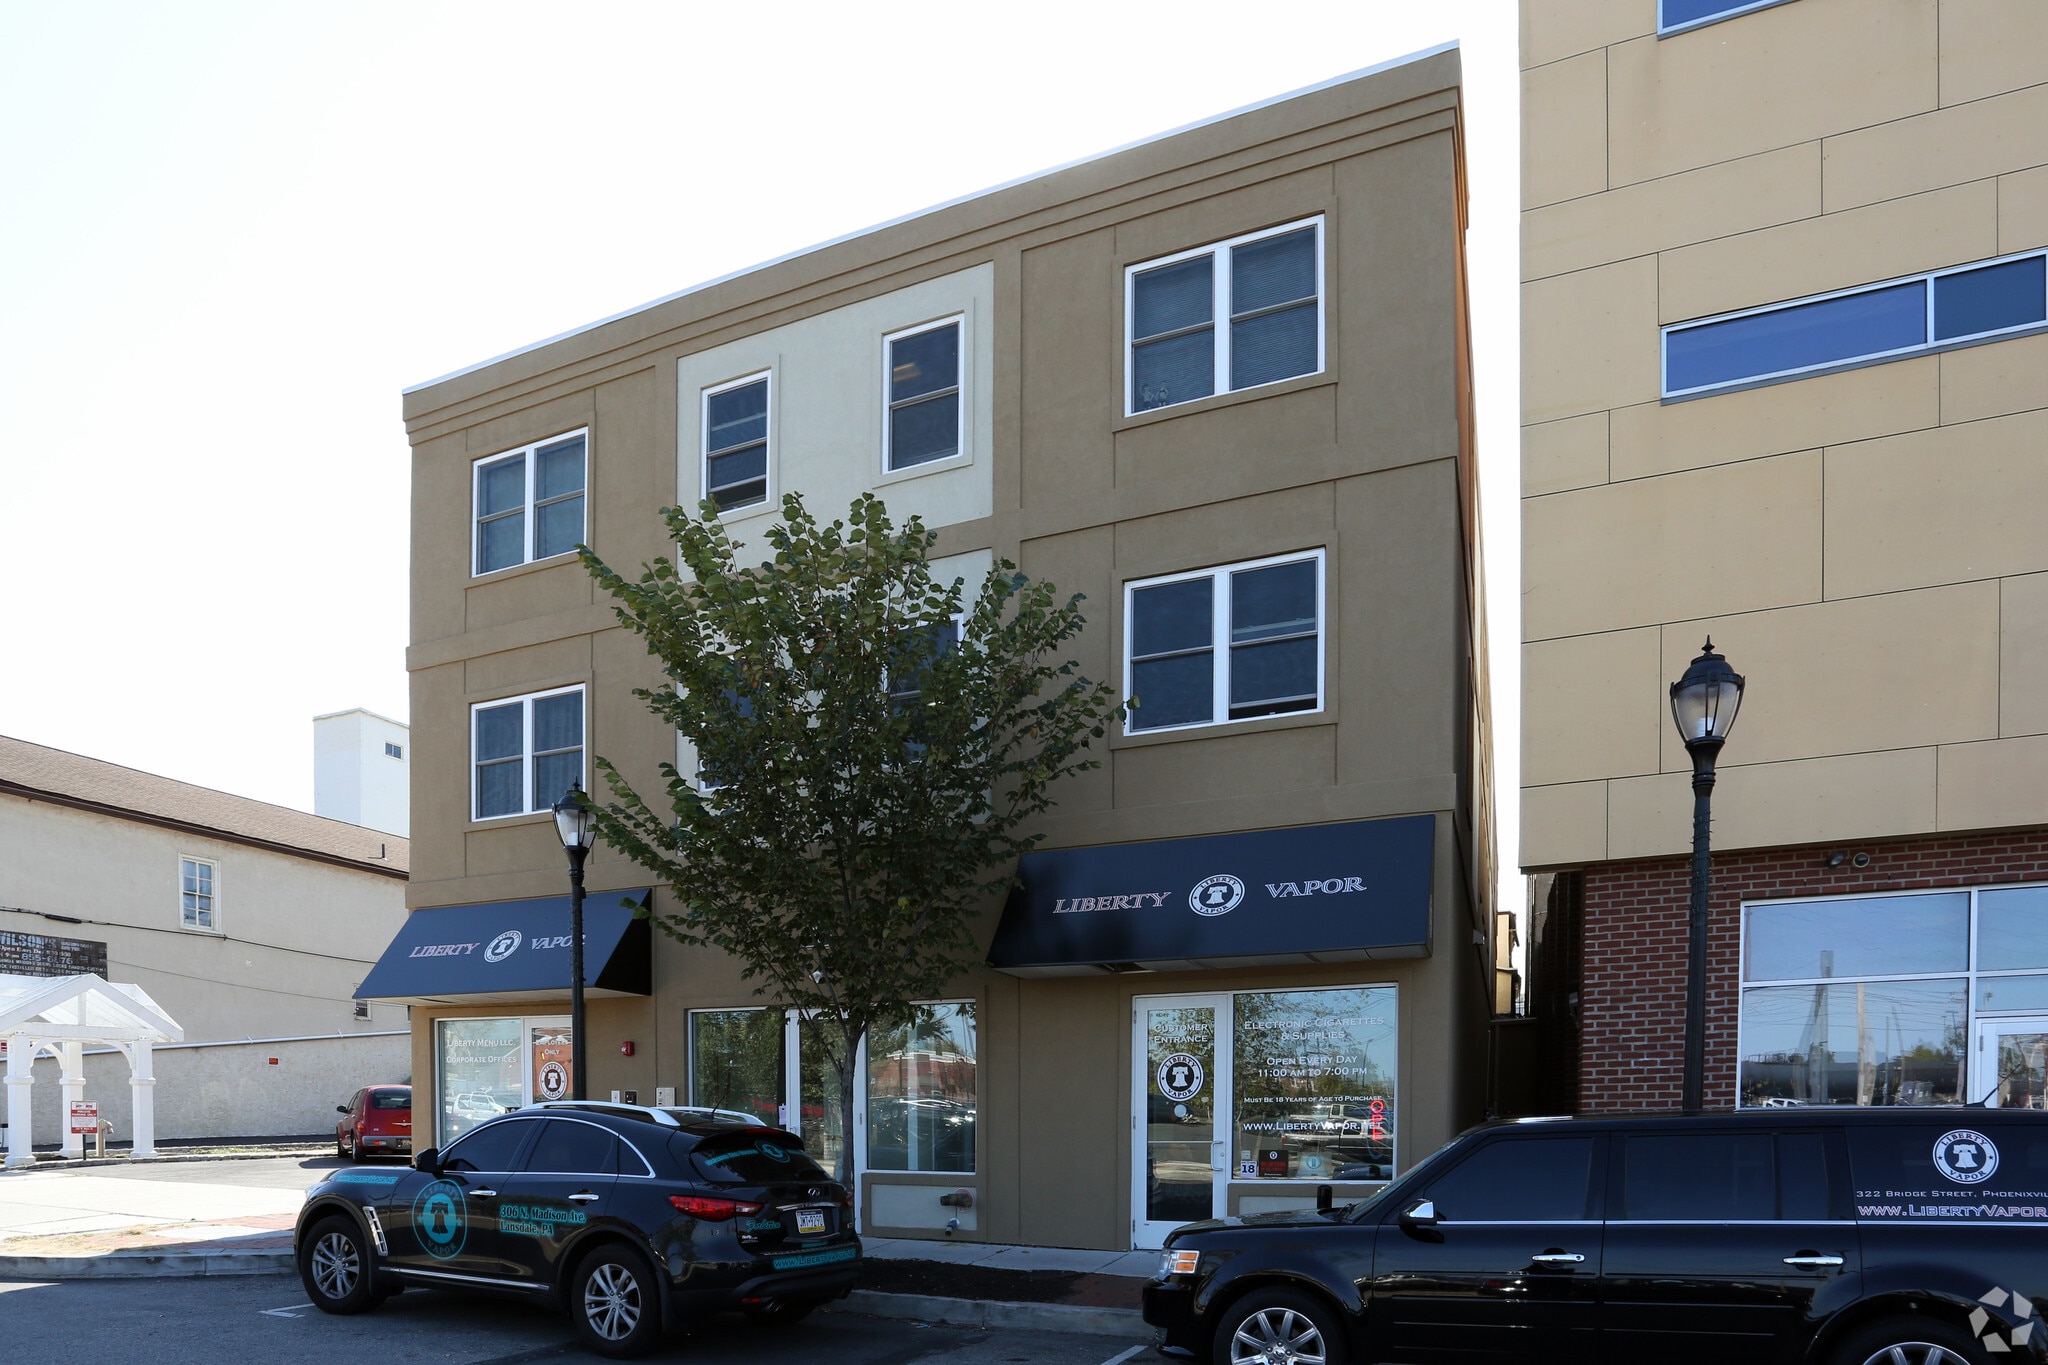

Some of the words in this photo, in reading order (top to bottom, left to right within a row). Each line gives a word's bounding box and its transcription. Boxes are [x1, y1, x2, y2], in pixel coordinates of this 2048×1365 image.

[1200, 877, 1238, 889] LIBERTY
[1052, 892, 1172, 914] LIBERTY
[1265, 876, 1368, 898] VAPOR
[1199, 905, 1230, 914] VAPOR
[408, 943, 480, 958] LIBERTY
[531, 935, 586, 950] VAPO
[1154, 1023, 1208, 1032] CUSTOMER
[1244, 1019, 1312, 1030] ELECTRONIC
[1315, 1016, 1384, 1027] CIGARETTES
[1154, 1035, 1208, 1043] ENTRANCE
[1281, 1032, 1290, 1040] &
[1292, 1031, 1345, 1040] SUPPLIES
[446, 1039, 476, 1047] LIBERTY
[477, 1038, 500, 1047] MENU
[446, 1055, 487, 1063] CORPORATE
[487, 1055, 517, 1063] OFFICES
[1165, 1055, 1197, 1069] LIBERTY
[1266, 1057, 1296, 1066] OPEN
[1299, 1056, 1334, 1065] EVERY
[1336, 1055, 1358, 1064] DAY
[1258, 1068, 1288, 1077] 11:00
[1289, 1069, 1305, 1077] AM
[1307, 1068, 1321, 1077] TO
[1324, 1067, 1349, 1076] 7:00
[1352, 1067, 1368, 1075] PM
[1168, 1088, 1193, 1098] VAPOR
[1941, 1132, 1988, 1147] LIBERTY
[1241, 1164, 1255, 1173] 18
[1948, 1170, 1987, 1181] VAPOR
[423, 1184, 461, 1201] LIBERTY
[1856, 1190, 1881, 1198] 322
[1885, 1190, 1927, 1198] BRIDGE
[1931, 1190, 1978, 1198] STREET,
[500, 1206, 518, 1217] 306
[520, 1207, 528, 1218] N.
[531, 1208, 567, 1221] Madison
[569, 1210, 586, 1223] Ave.
[500, 1221, 540, 1235] Lansdale,
[542, 1224, 554, 1235] PA
[427, 1239, 457, 1254] VAPOR
